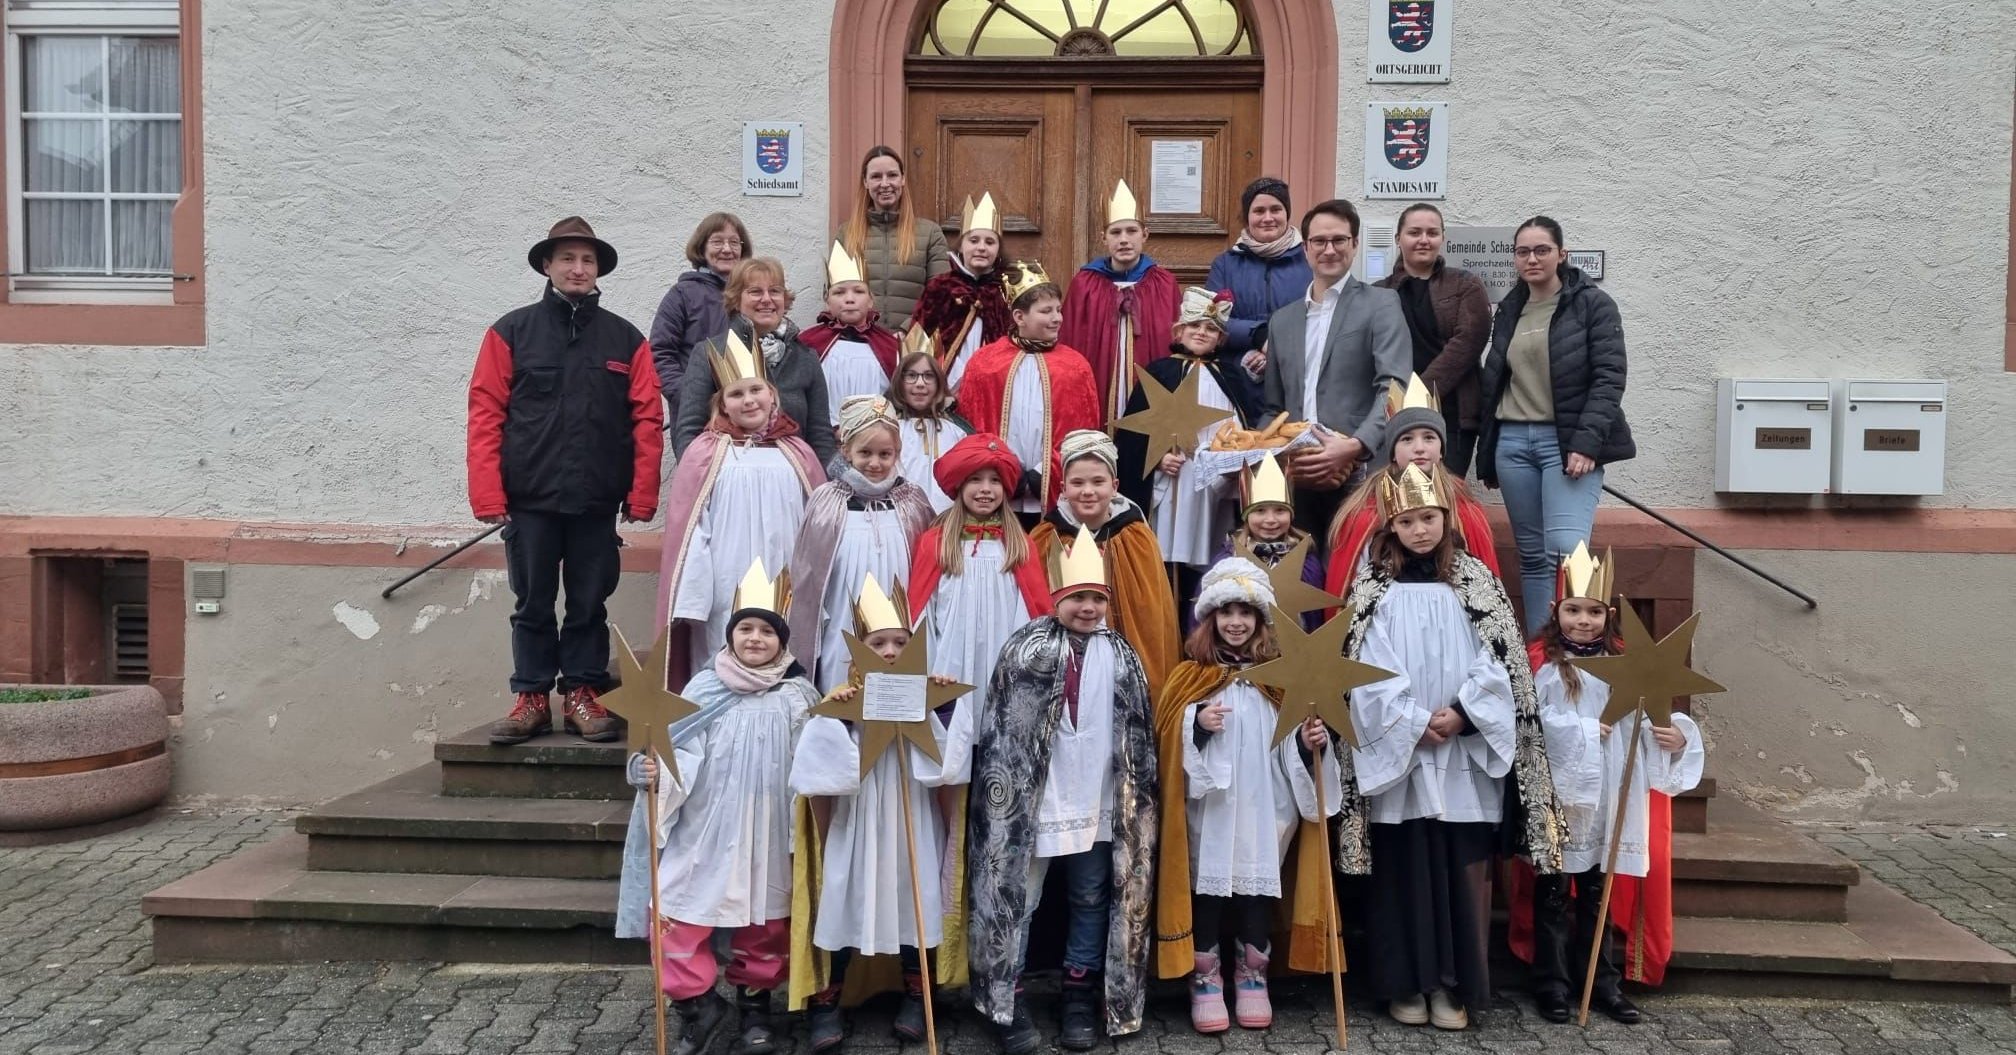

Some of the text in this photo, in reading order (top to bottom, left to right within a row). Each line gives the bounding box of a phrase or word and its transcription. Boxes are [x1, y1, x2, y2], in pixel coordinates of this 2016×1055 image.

[1375, 64, 1442, 75] ORTSGERICHT
[747, 178, 799, 189] Schiedsamt
[1372, 181, 1439, 193] STANDESAMT
[1446, 240, 1516, 254] Gemeinde Schaa
[1462, 259, 1515, 268] Sprechzeite
[1760, 434, 1806, 445] Zeitungen
[1879, 435, 1906, 445] Briefe
